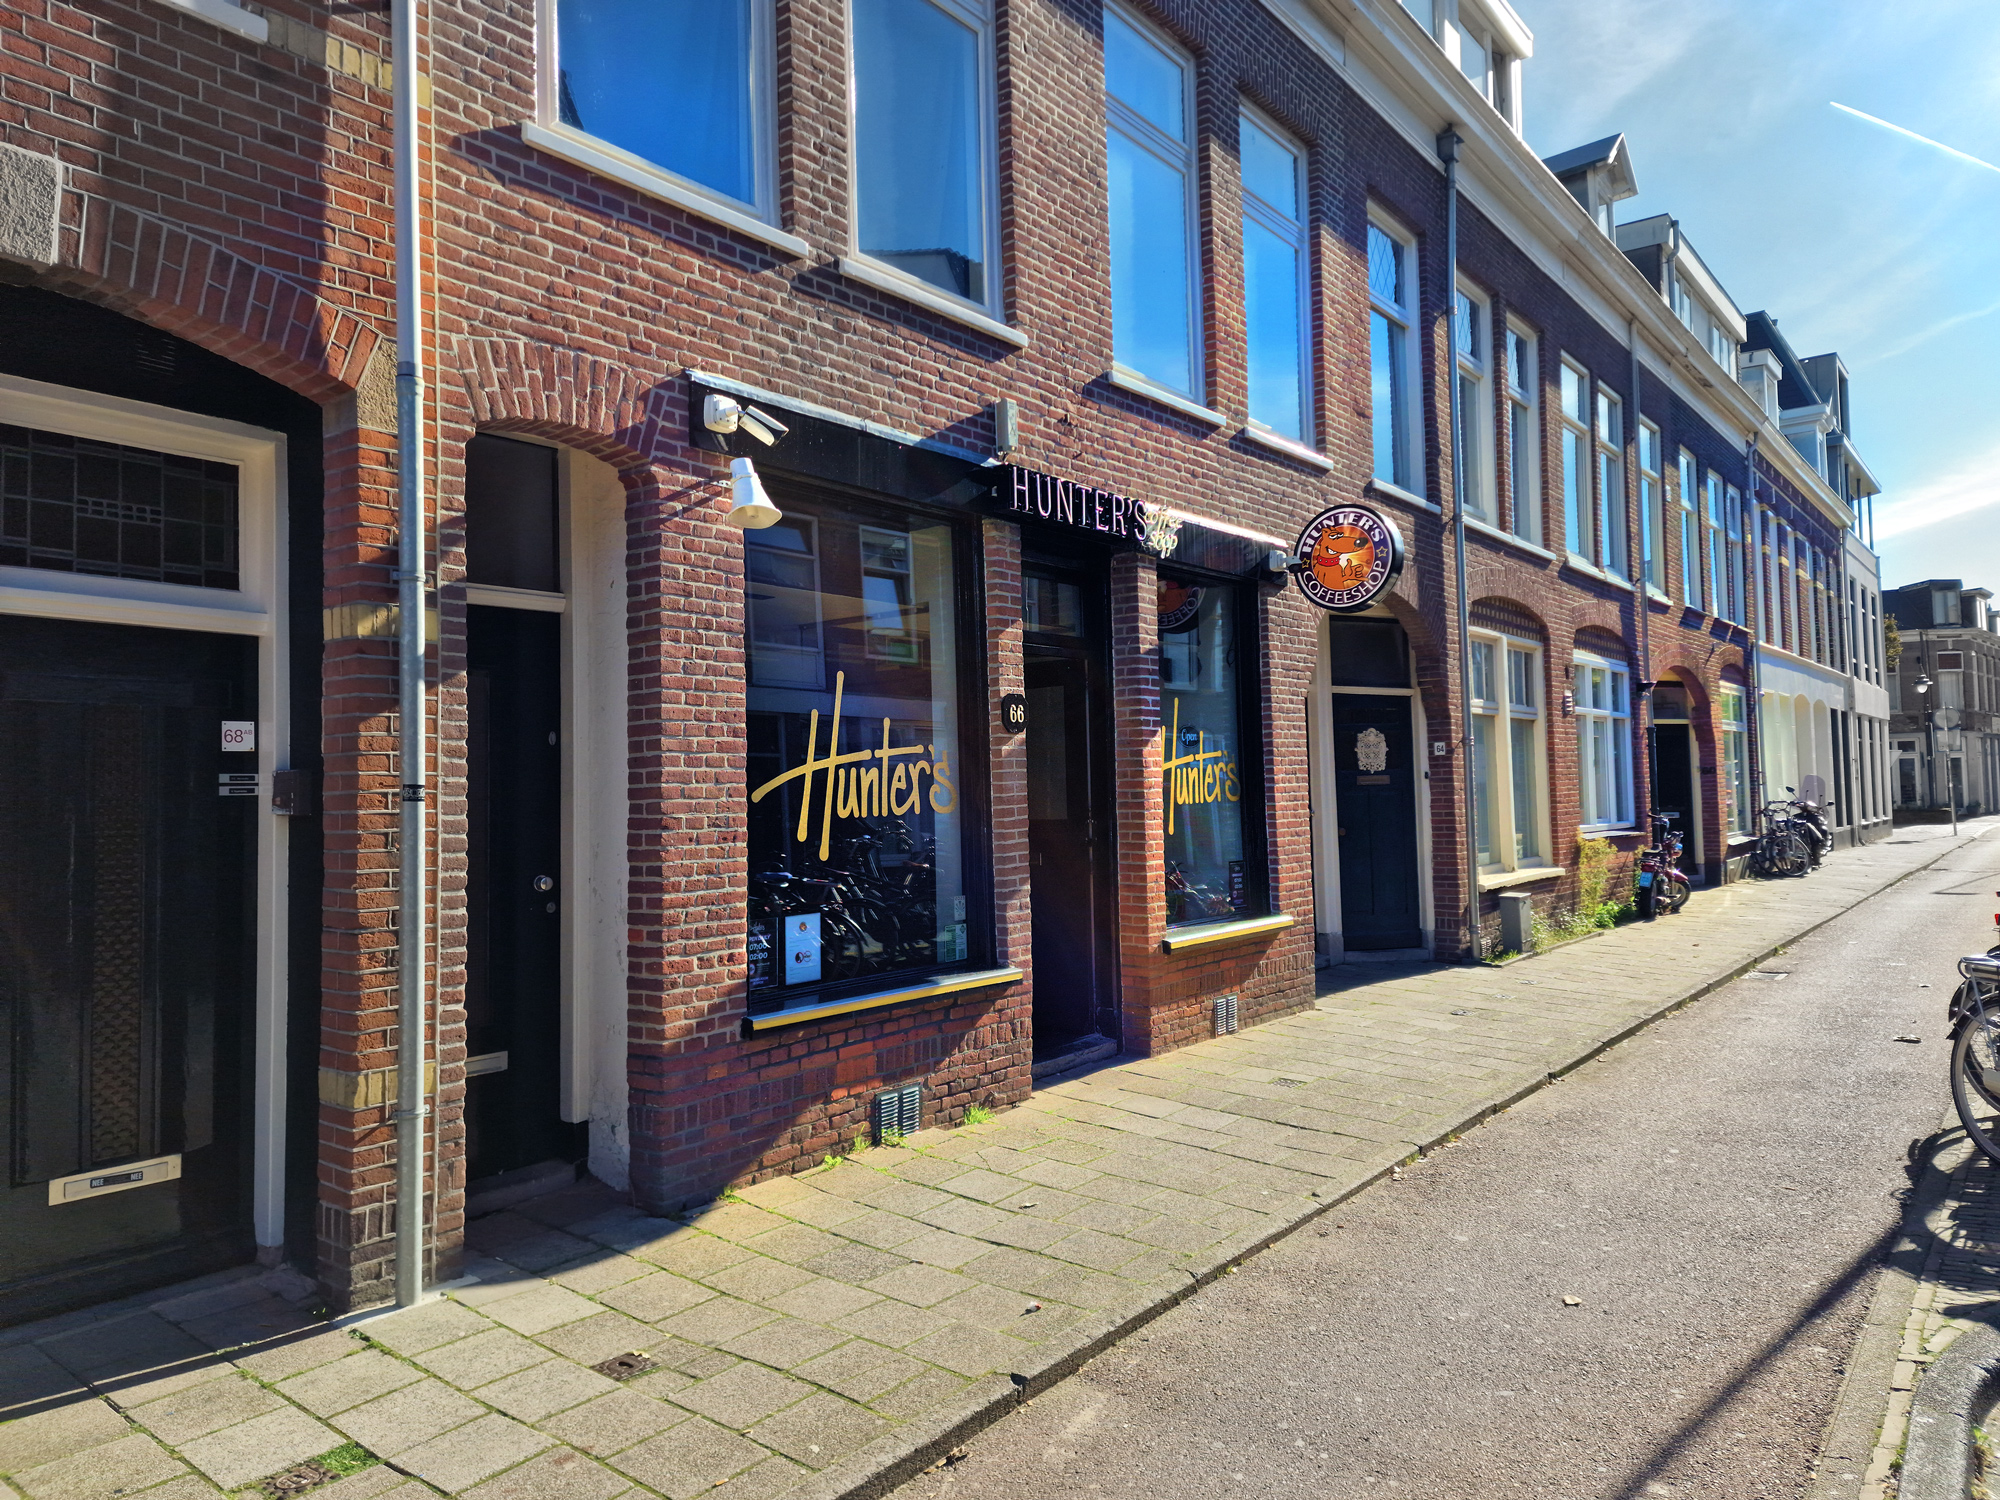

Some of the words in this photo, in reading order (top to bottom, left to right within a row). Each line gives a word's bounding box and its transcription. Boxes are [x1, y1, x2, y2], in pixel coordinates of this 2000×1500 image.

[1012, 466, 1148, 541] HUNTER'S
[1302, 512, 1384, 553] HUNTER'S
[1303, 560, 1385, 604] COFFEESHOP
[1010, 704, 1024, 723] 66
[224, 729, 243, 743] 68
[1436, 744, 1444, 753] 64
[751, 670, 958, 862] Hunter's
[1161, 697, 1241, 835] Hunter's
[91, 1179, 104, 1187] NEE
[130, 1173, 143, 1181] NEE
